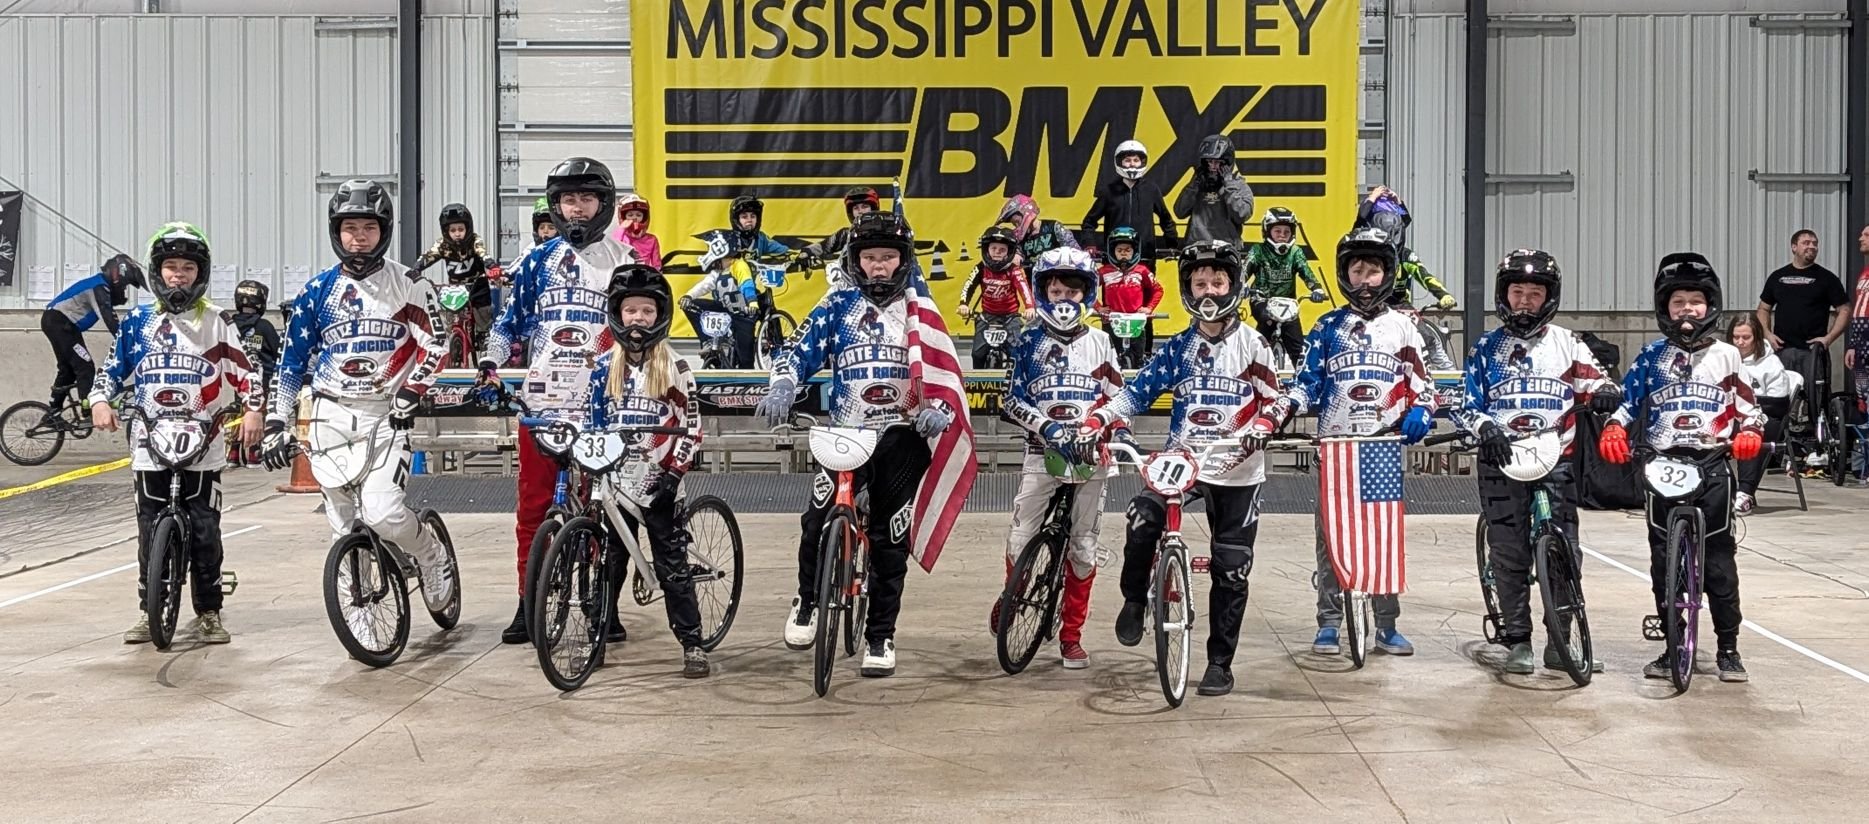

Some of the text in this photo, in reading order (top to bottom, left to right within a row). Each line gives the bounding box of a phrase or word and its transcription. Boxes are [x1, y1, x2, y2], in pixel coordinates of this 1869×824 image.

[666, 0, 1328, 59] MISSISSIPPI VALLEY
[904, 85, 1263, 199] BMX
[565, 309, 606, 325] RACING
[706, 316, 722, 329] 185
[357, 320, 401, 338] EIGHT
[351, 339, 396, 353] RACING
[169, 353, 210, 375] EIGHT
[838, 345, 873, 368] GATE
[1365, 352, 1401, 374] EIGHT
[164, 373, 202, 385] RACIN
[842, 366, 911, 381] BMX RACIN
[1358, 369, 1396, 384] RACING
[426, 387, 471, 396] OLINE
[700, 386, 742, 395] EAST
[980, 381, 1003, 390] VALL
[1207, 376, 1248, 395] EIGHT
[1526, 378, 1569, 399] EIGHT
[1686, 383, 1725, 404] EIGHT
[627, 397, 663, 414] EIGHT
[1200, 393, 1242, 406] RACING
[1520, 398, 1563, 411] RACING
[1681, 399, 1719, 412] RACING
[621, 414, 661, 426] RACING
[584, 437, 606, 458] 33
[835, 435, 850, 454] 6
[1156, 460, 1186, 486] 10
[1660, 465, 1688, 489] 32
